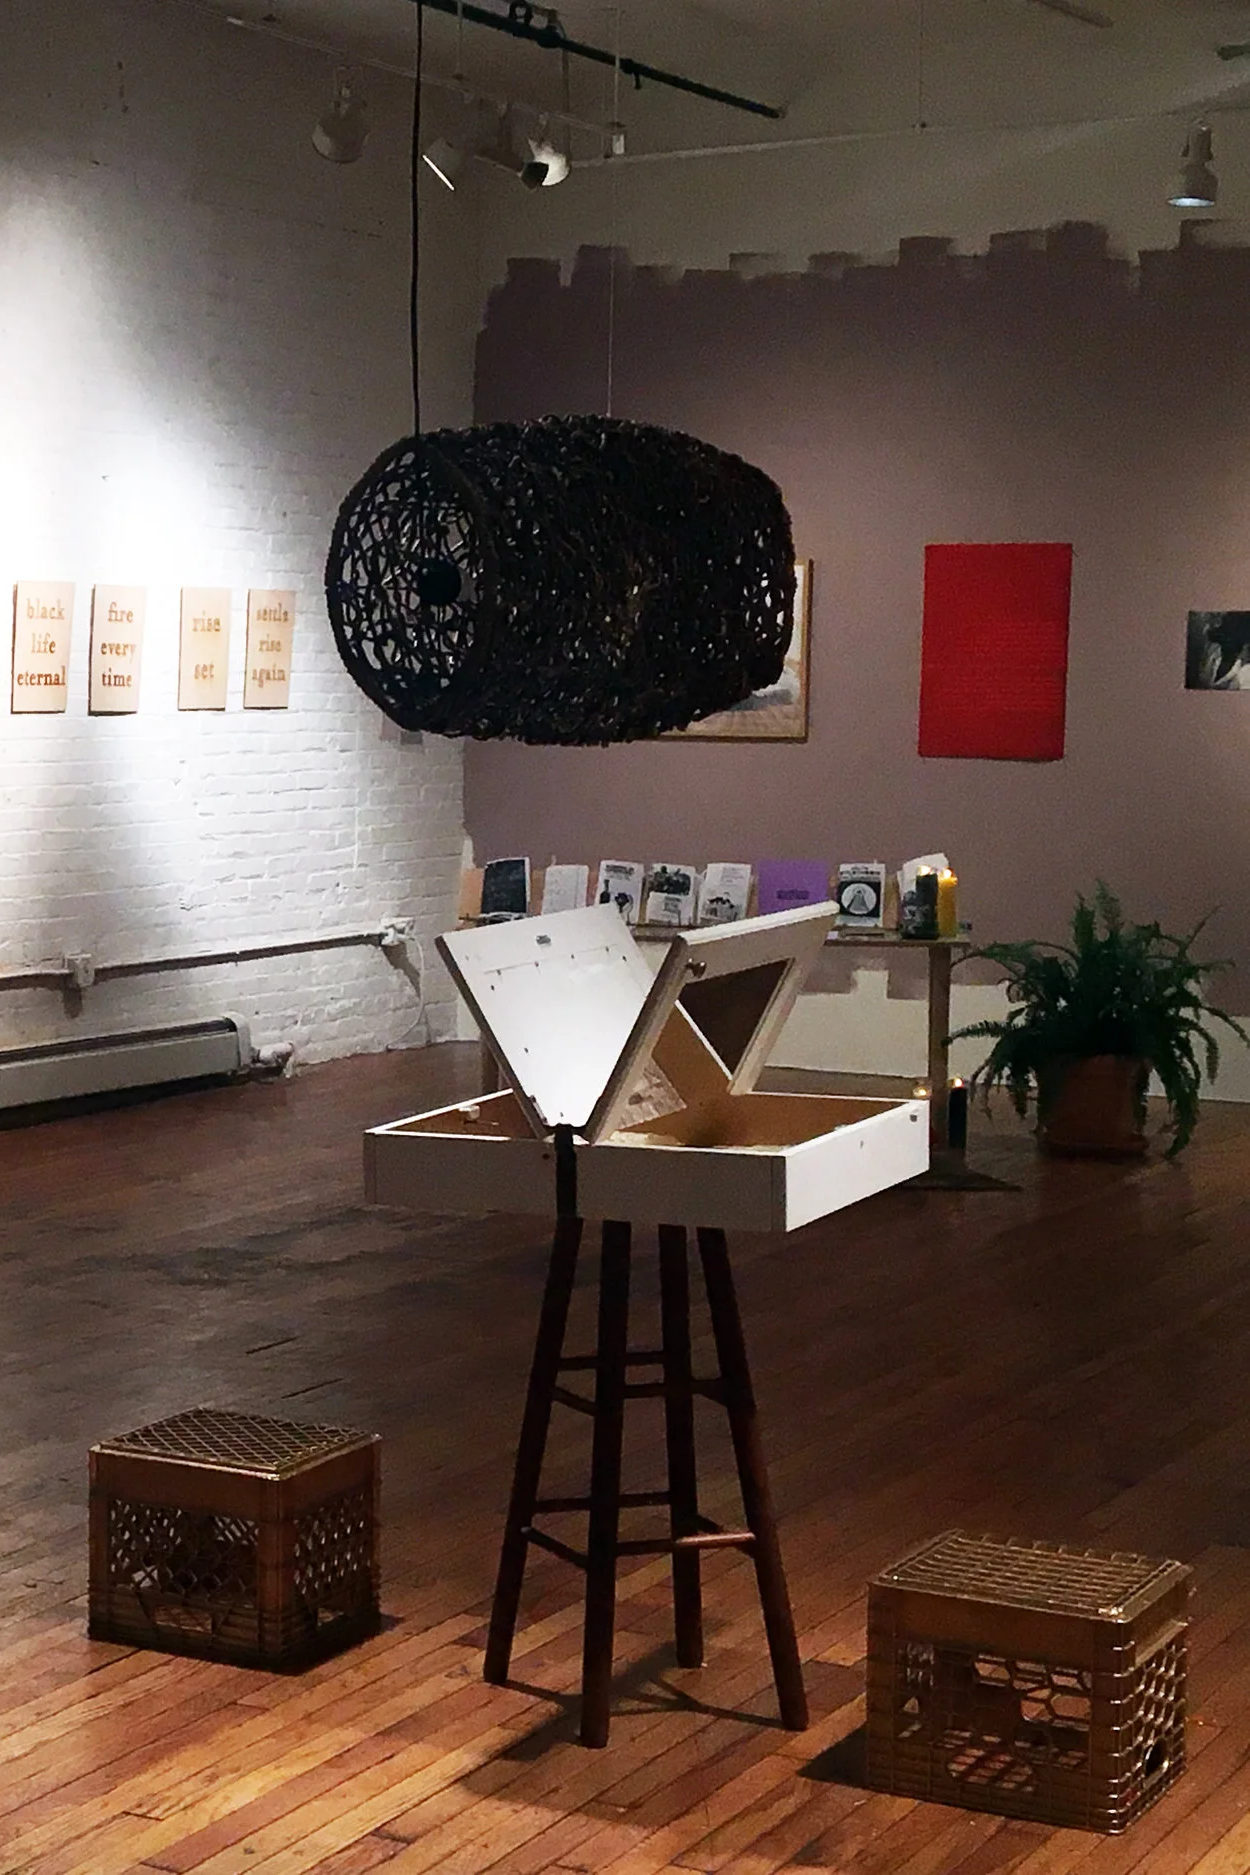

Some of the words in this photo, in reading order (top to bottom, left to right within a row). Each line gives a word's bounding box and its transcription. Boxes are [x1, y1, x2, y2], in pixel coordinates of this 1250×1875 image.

[26, 598, 65, 620] black
[107, 601, 134, 623] fire
[192, 609, 221, 632] rise
[31, 632, 56, 654] life
[100, 641, 137, 664] every
[258, 633, 282, 652] rise
[17, 665, 66, 686] eternal
[102, 668, 132, 688] time
[251, 661, 287, 688] again
